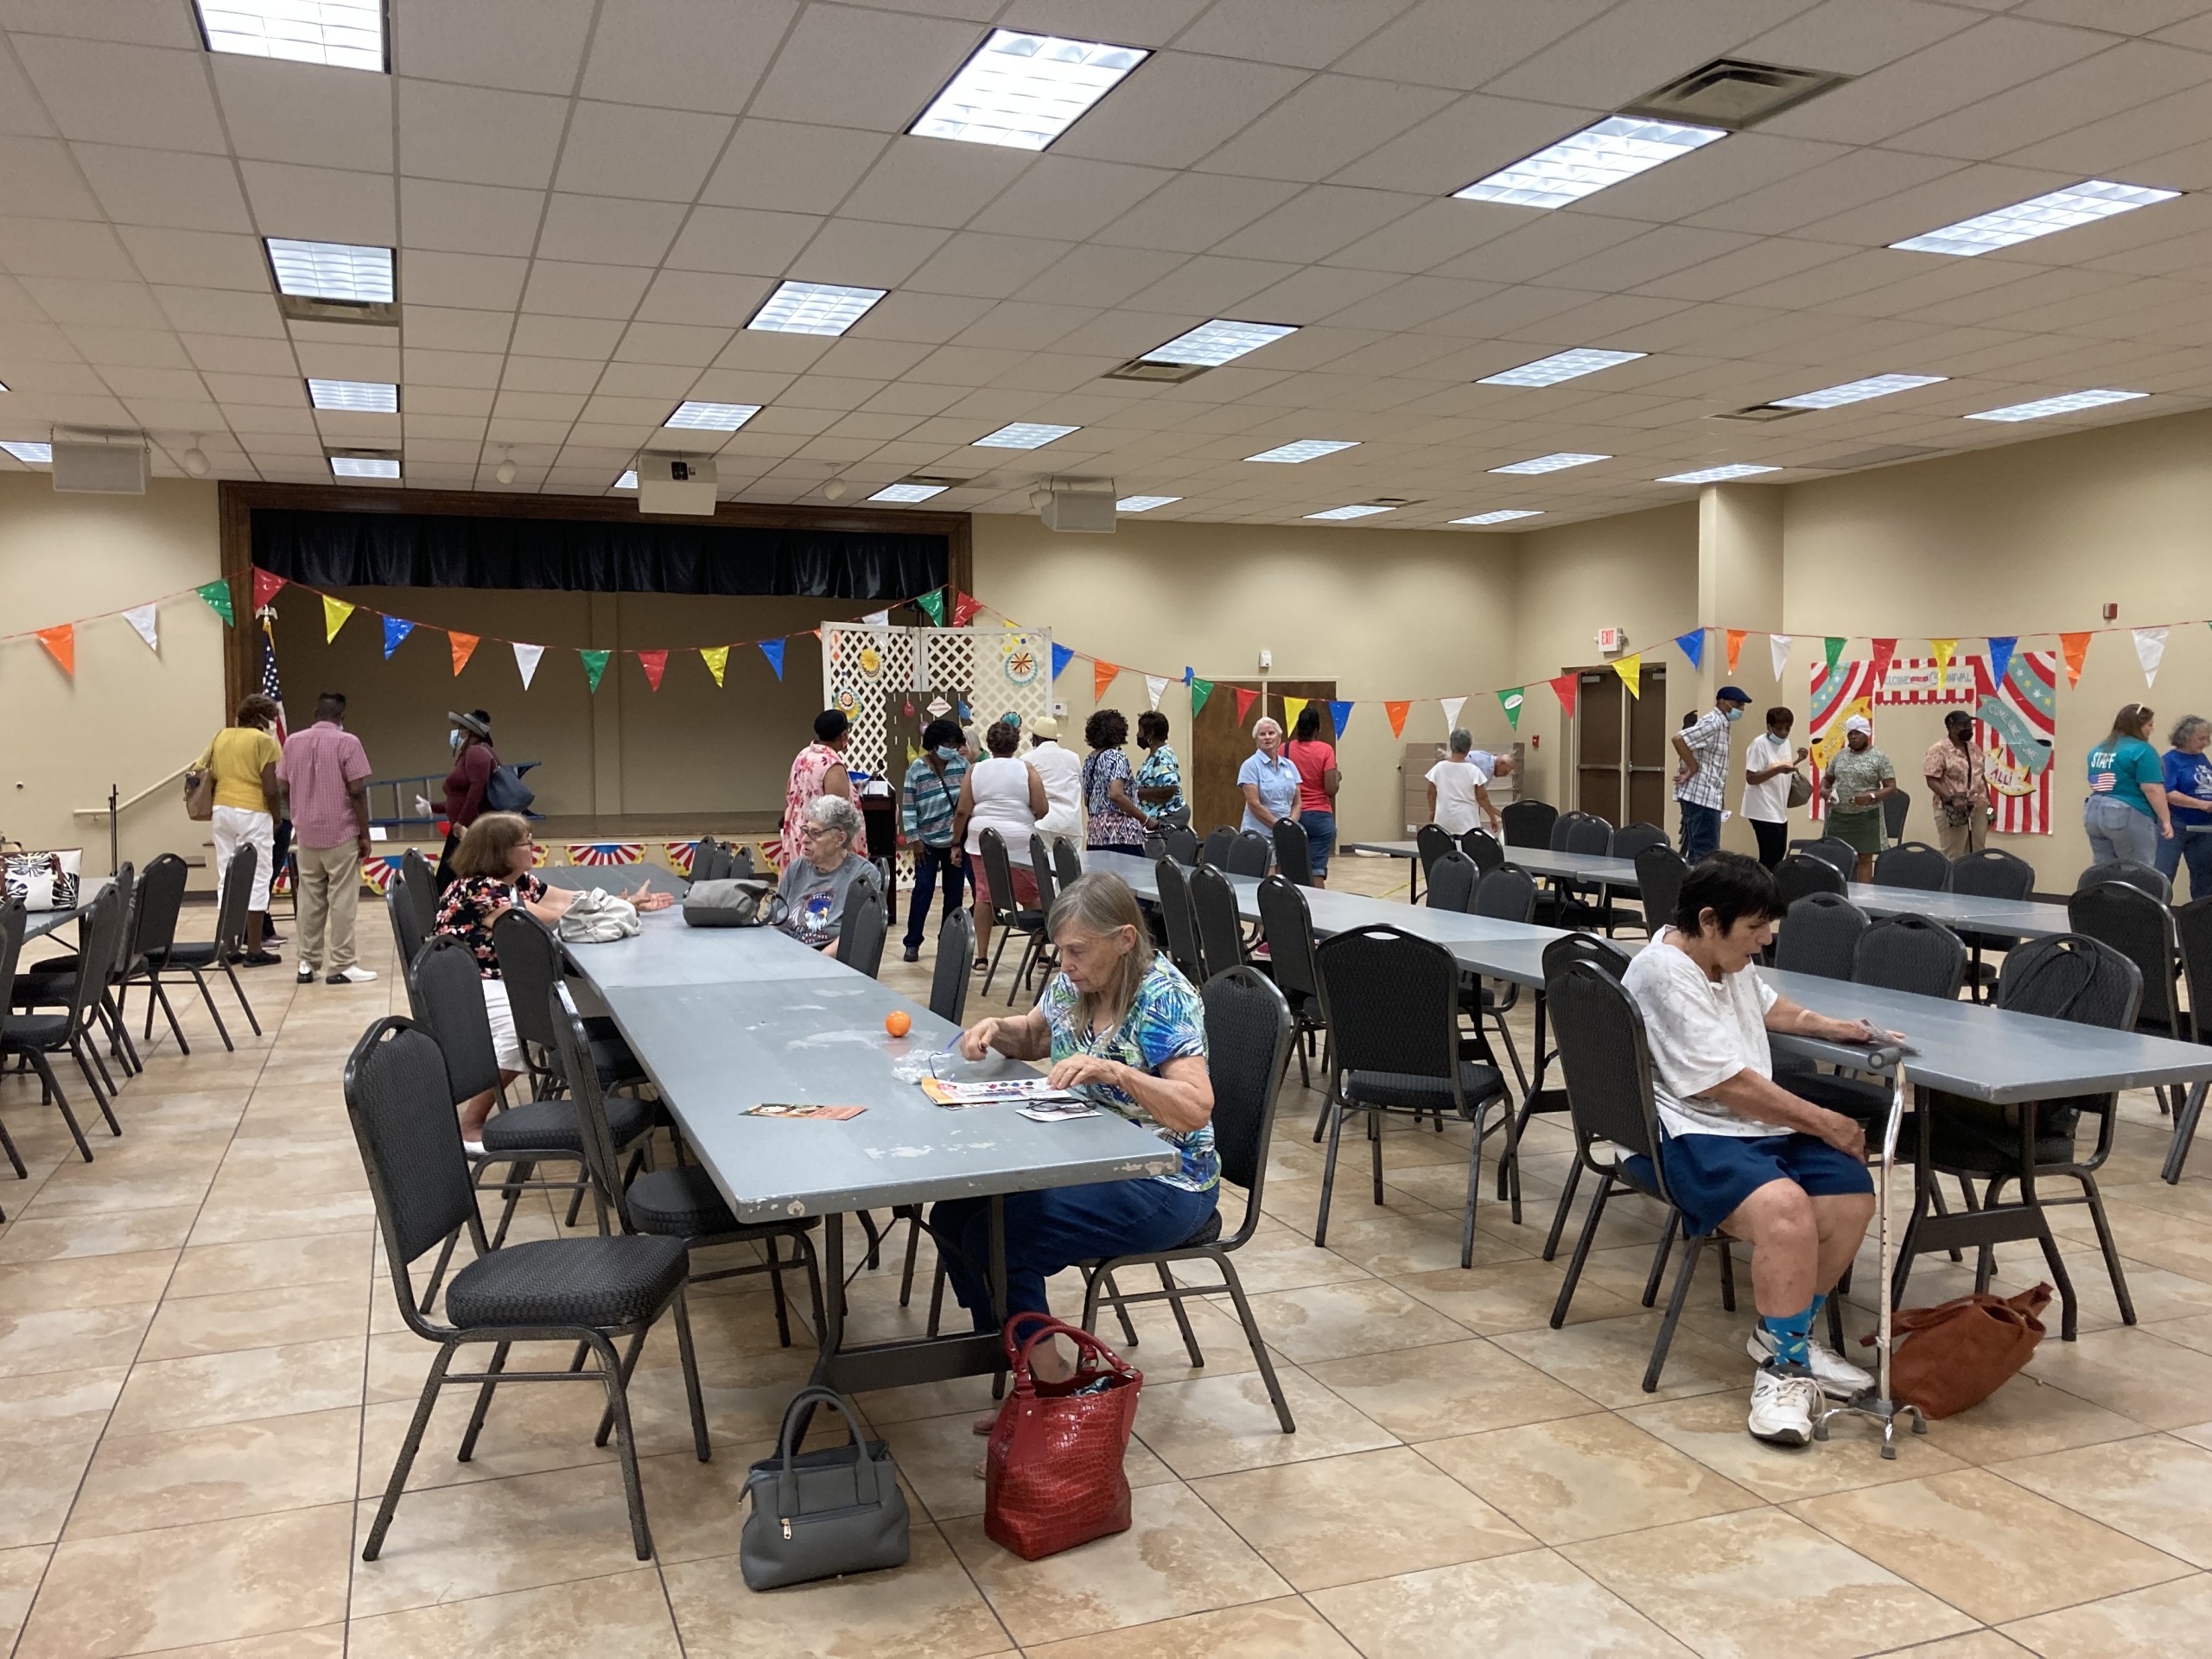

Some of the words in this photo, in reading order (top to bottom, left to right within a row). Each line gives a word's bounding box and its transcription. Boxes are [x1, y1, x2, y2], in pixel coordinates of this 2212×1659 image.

[1602, 630, 1614, 645] EXIT
[1929, 671, 1972, 685] CRNIVAL
[1988, 704, 2009, 724] COME
[2007, 720, 2020, 739] ONE
[2018, 739, 2038, 762] COME
[2091, 752, 2117, 769] STAFF
